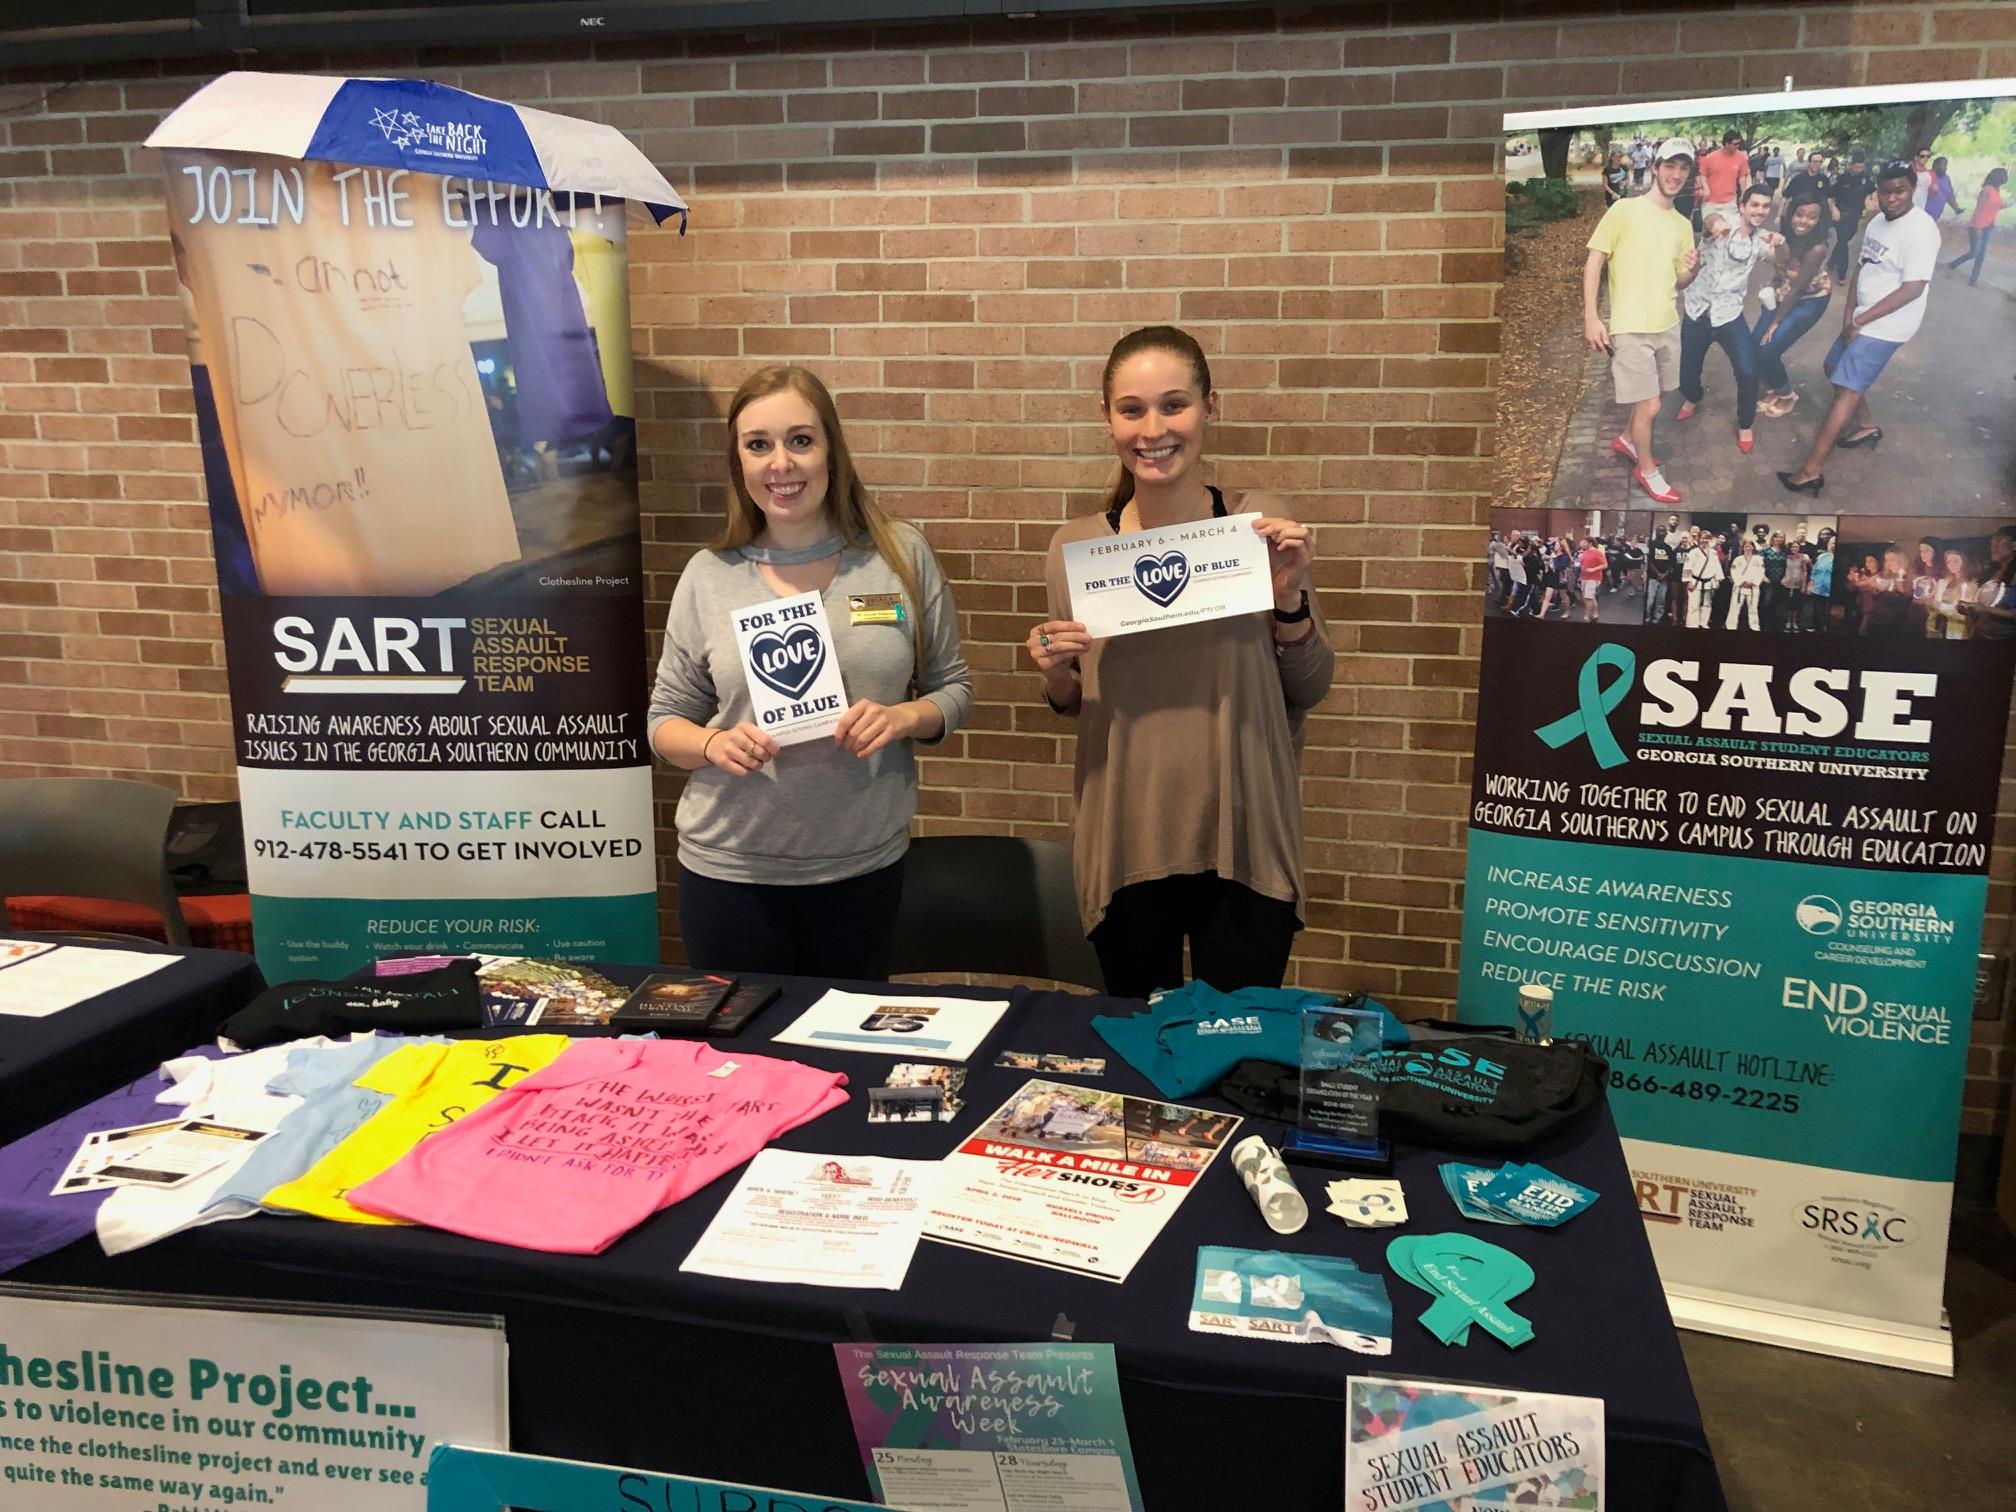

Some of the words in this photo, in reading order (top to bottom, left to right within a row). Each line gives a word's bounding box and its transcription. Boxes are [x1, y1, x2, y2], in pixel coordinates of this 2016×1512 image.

[580, 17, 605, 26] NEC
[426, 123, 445, 135] TAKE
[448, 122, 482, 139] BACK
[428, 134, 443, 146] THE
[446, 136, 487, 154] NIGHT
[183, 165, 304, 225] JOIN
[334, 168, 415, 227] THE
[353, 260, 410, 293] not
[1090, 538, 1153, 557] FEBRUARY
[1158, 535, 1166, 545] 6
[1180, 527, 1226, 542] MARCH
[1230, 525, 1238, 534] 4
[539, 575, 592, 586] Clothesline
[595, 575, 630, 587] Project
[1085, 579, 1108, 591] FOR
[1109, 576, 1131, 587] THE
[1142, 562, 1185, 587] LOVE
[1194, 564, 1210, 573] OF
[1211, 559, 1240, 570] BLUE
[471, 617, 556, 635] SEXUAL
[739, 612, 776, 632] FOR
[778, 602, 817, 622] THE
[273, 617, 466, 674] SART
[473, 637, 568, 654] ASSAULT
[761, 638, 817, 675] LOVE
[473, 656, 591, 673] RESPONSE
[474, 676, 534, 693] TEAM
[763, 707, 789, 724] OF
[792, 695, 840, 718] BLUE
[1640, 658, 1939, 745] SASE
[246, 713, 321, 736] RAISING
[328, 714, 422, 736] AWARENESS
[428, 715, 482, 736] ABOUT
[488, 714, 551, 736] SEXUAL
[556, 712, 631, 735] ASSAULT
[245, 739, 297, 761] ISSUES
[303, 740, 328, 762] IN
[333, 741, 361, 762] THE
[368, 741, 442, 763] GEORGIA
[447, 741, 529, 763] SOUTHERN
[534, 739, 638, 762] COMMUNITY
[1638, 733, 1694, 746] SEXUAL
[1695, 735, 1758, 751] ASSAULT
[1760, 741, 1831, 757] STUDENT
[1834, 746, 1930, 764] EDUCATORS
[1636, 749, 1718, 767] GEORGIA
[1720, 754, 1817, 774] SOUTHERN
[1818, 761, 1929, 782] UNIVERSITY
[1484, 773, 1570, 804] WORKING
[1579, 783, 1668, 813] TOGETHER
[1677, 791, 1699, 814] TO
[1707, 794, 1747, 820] END
[1756, 799, 1832, 828] SEXUAL
[1842, 807, 1938, 835] ASSAULT
[1946, 811, 1978, 835] ON
[280, 810, 392, 830] FACULTY
[399, 811, 451, 830] AND
[458, 811, 533, 830] STAFF
[540, 810, 607, 830] CALL
[1474, 803, 1553, 833] GEORGIA
[1678, 822, 1755, 851] CAMPUS
[1763, 831, 1853, 861] THROUGH
[1862, 838, 1987, 868] EDUCATION
[254, 839, 408, 861] 912-478-5541
[414, 842, 450, 861] TO
[457, 842, 507, 861] GET
[515, 839, 642, 860] INVOLVED
[1487, 865, 1592, 895] INCREASE
[1596, 878, 1733, 910] AWARENESS
[1485, 898, 1589, 928] PROMOTE
[1594, 912, 1730, 941] SENSITIVITY
[1849, 899, 1937, 920] GEORGIA
[367, 919, 438, 933] REDUCE
[444, 919, 493, 933] YOUR
[498, 919, 541, 933] RISK:
[1845, 928, 1952, 945] UNIVERSITY
[1847, 915, 1955, 934] SOUTHERN
[426, 942, 448, 950] drink
[462, 941, 524, 950] Communicate
[553, 940, 571, 948] Use
[1483, 930, 1617, 964] ENCOURAGE
[1624, 946, 1761, 980] DISCUSSION
[1481, 962, 1566, 991] REDUCE
[1572, 975, 1612, 997] THE
[1618, 980, 1667, 1002] RISK
[1782, 976, 1867, 1017] END
[1198, 1016, 1259, 1029] SASE
[1871, 1001, 1951, 1025] SEXUAL
[1823, 1016, 1950, 1046] VIOLENCE
[1642, 1041, 1730, 1072] ASSAULT
[472, 1063, 529, 1090] I
[1441, 1084, 1496, 1104] UNIVERSITY
[984, 1144, 1055, 1164] WALK
[1057, 1156, 1076, 1168] A
[1079, 1158, 1139, 1177] MILE
[1142, 1169, 1171, 1182] IN
[1057, 1172, 1139, 1192] SHOES
[1631, 1169, 1690, 1186] SOUTHERN
[1691, 1179, 1759, 1197] UNIVERSITY
[1523, 1184, 1575, 1208] END
[1688, 1200, 1747, 1215] ASSAULT
[1689, 1189, 1738, 1205] SEXUAL
[1688, 1209, 1755, 1227] RESPONSE
[1688, 1219, 1723, 1231] TEAM
[875, 1350, 913, 1359] Sexual
[914, 1350, 953, 1360] Assault
[955, 1350, 1009, 1361] Response
[1012, 1351, 1044, 1360] Team
[1046, 1350, 1095, 1361] Presents
[188, 1358, 418, 1419] Project...
[858, 1363, 960, 1393] Sexual
[970, 1365, 1095, 1395] Assault
[903, 1388, 1064, 1417] Awareness
[14, 1399, 42, 1422] to
[50, 1400, 165, 1432] violence
[173, 1409, 199, 1434] in
[208, 1416, 256, 1438] our
[262, 1420, 426, 1458] community
[950, 1410, 1022, 1435] Week
[40, 1435, 73, 1456] the
[78, 1439, 192, 1467] clothesline
[198, 1451, 273, 1477] project
[278, 1459, 319, 1477] and
[325, 1462, 373, 1483] ever
[378, 1467, 415, 1484] see
[876, 1452, 894, 1463] 25
[1368, 1440, 1448, 1483] SEXUAL
[1456, 1412, 1542, 1459] ASSAULT
[999, 1455, 1018, 1466] 28
[1361, 1467, 1453, 1512] STUDENT
[1460, 1432, 1580, 1485] EDUCATORS
[4, 1466, 56, 1488] quite
[61, 1467, 94, 1487] the
[100, 1471, 154, 1494] same
[159, 1478, 203, 1500] way
[209, 1484, 284, 1505] again."
